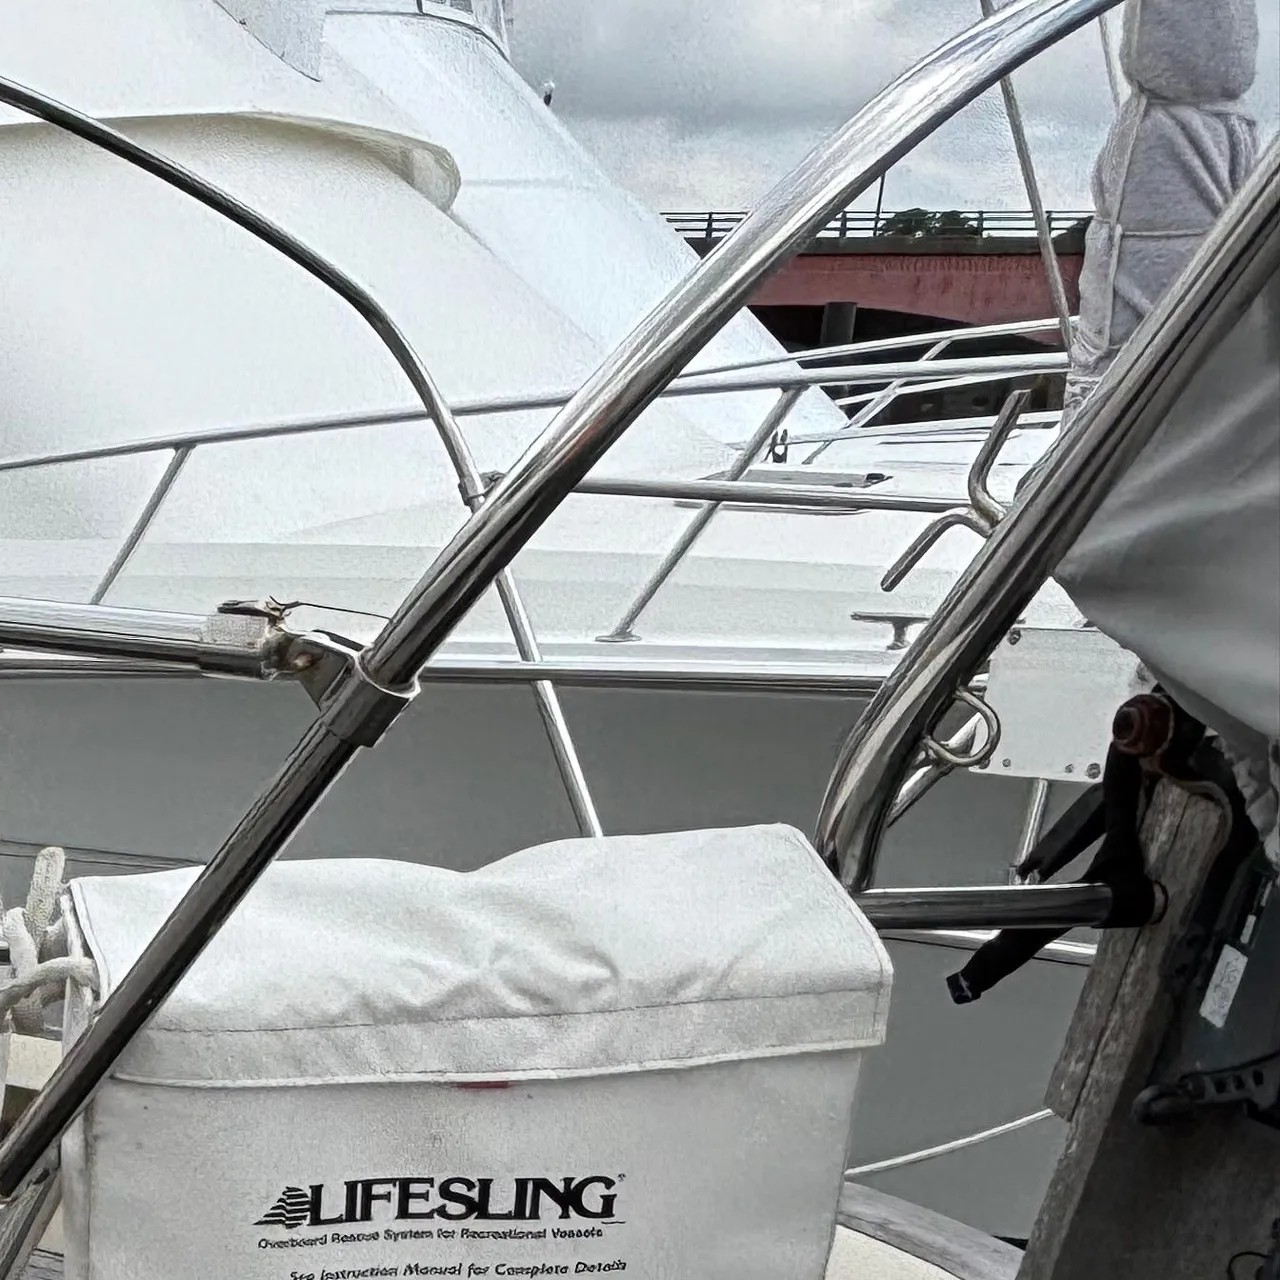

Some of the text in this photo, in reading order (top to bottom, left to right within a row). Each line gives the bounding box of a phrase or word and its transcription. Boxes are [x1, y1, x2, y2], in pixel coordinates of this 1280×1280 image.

[307, 1176, 617, 1226] LIFESLING
[437, 1227, 456, 1239] for
[320, 1265, 398, 1280] Instruction
[403, 1262, 462, 1277] Manual
[467, 1263, 489, 1278] for
